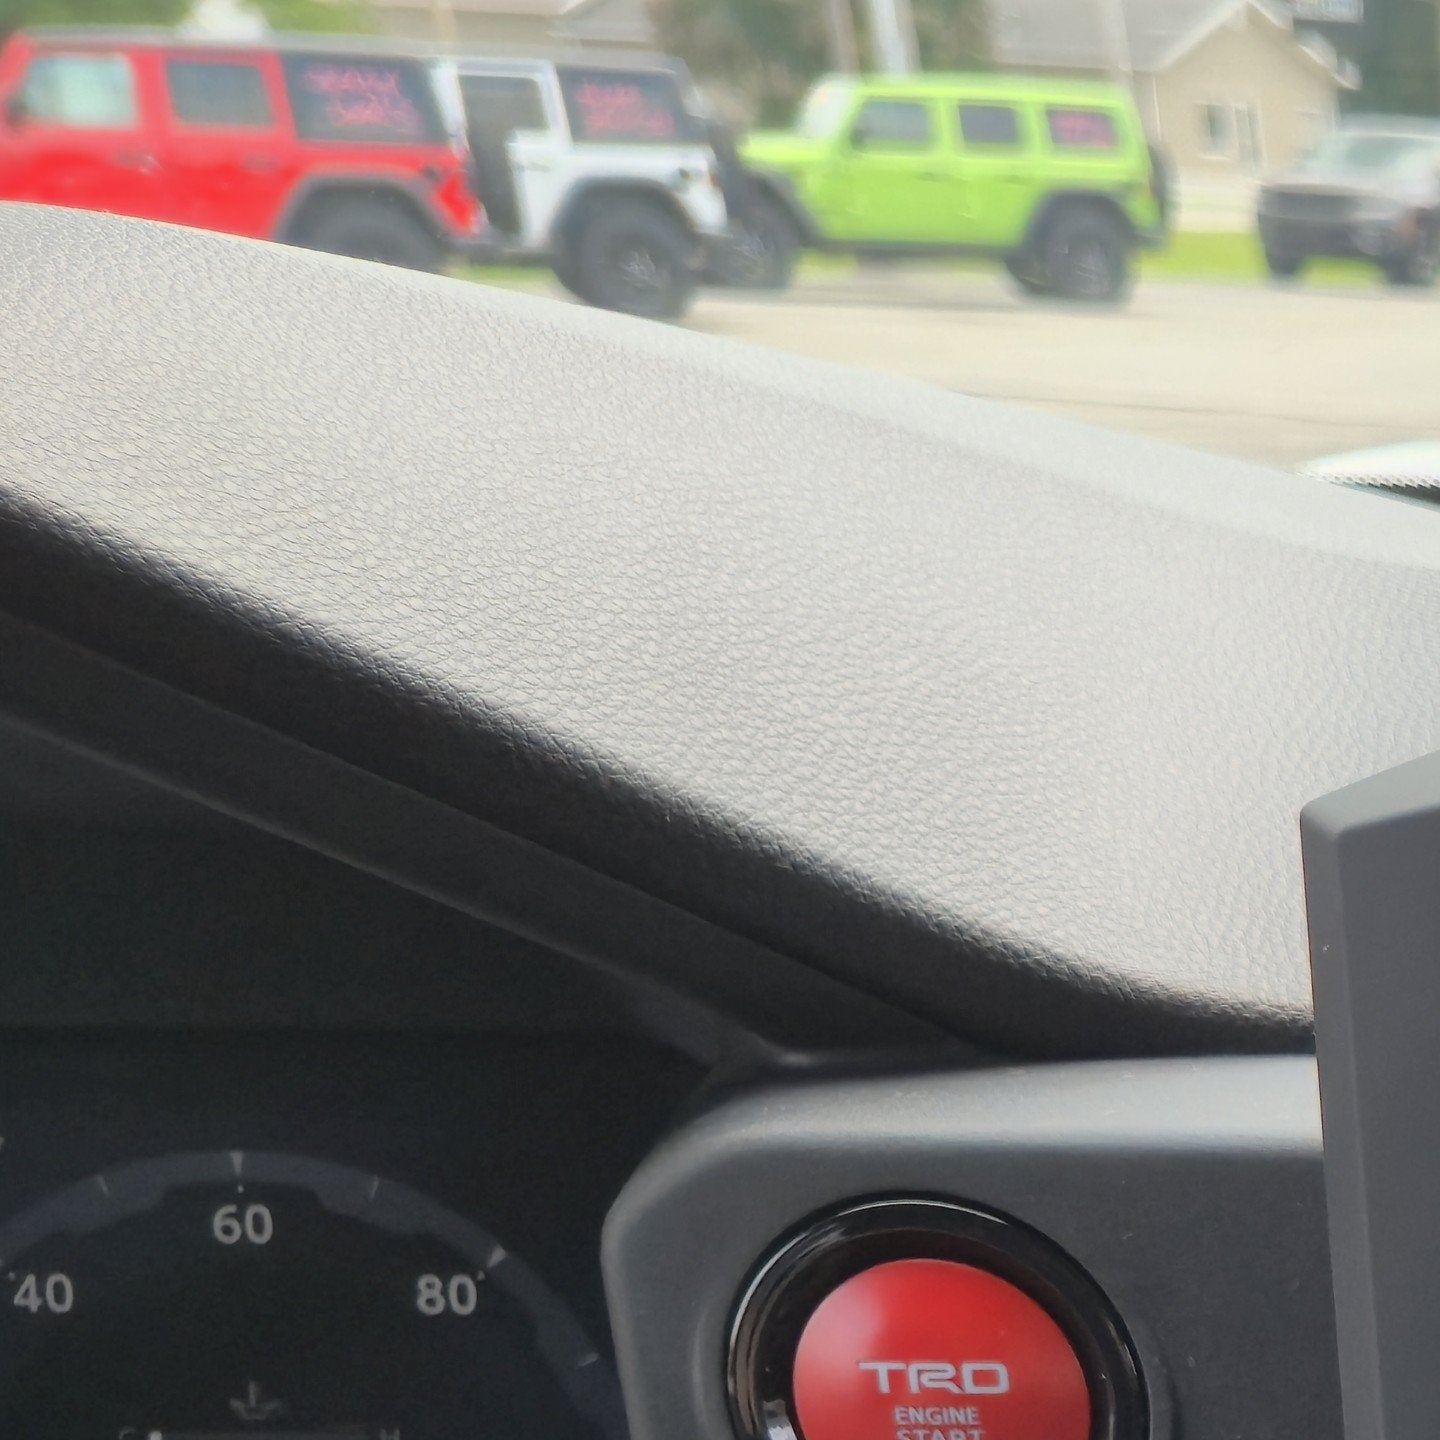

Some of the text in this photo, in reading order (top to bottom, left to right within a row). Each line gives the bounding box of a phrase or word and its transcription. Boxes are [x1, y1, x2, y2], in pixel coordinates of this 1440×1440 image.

[212, 1204, 274, 1246] 60
[12, 1273, 75, 1314] 40
[415, 1273, 478, 1316] 80
[857, 1361, 1011, 1395] TRD
[893, 1406, 980, 1426] ENGINE
